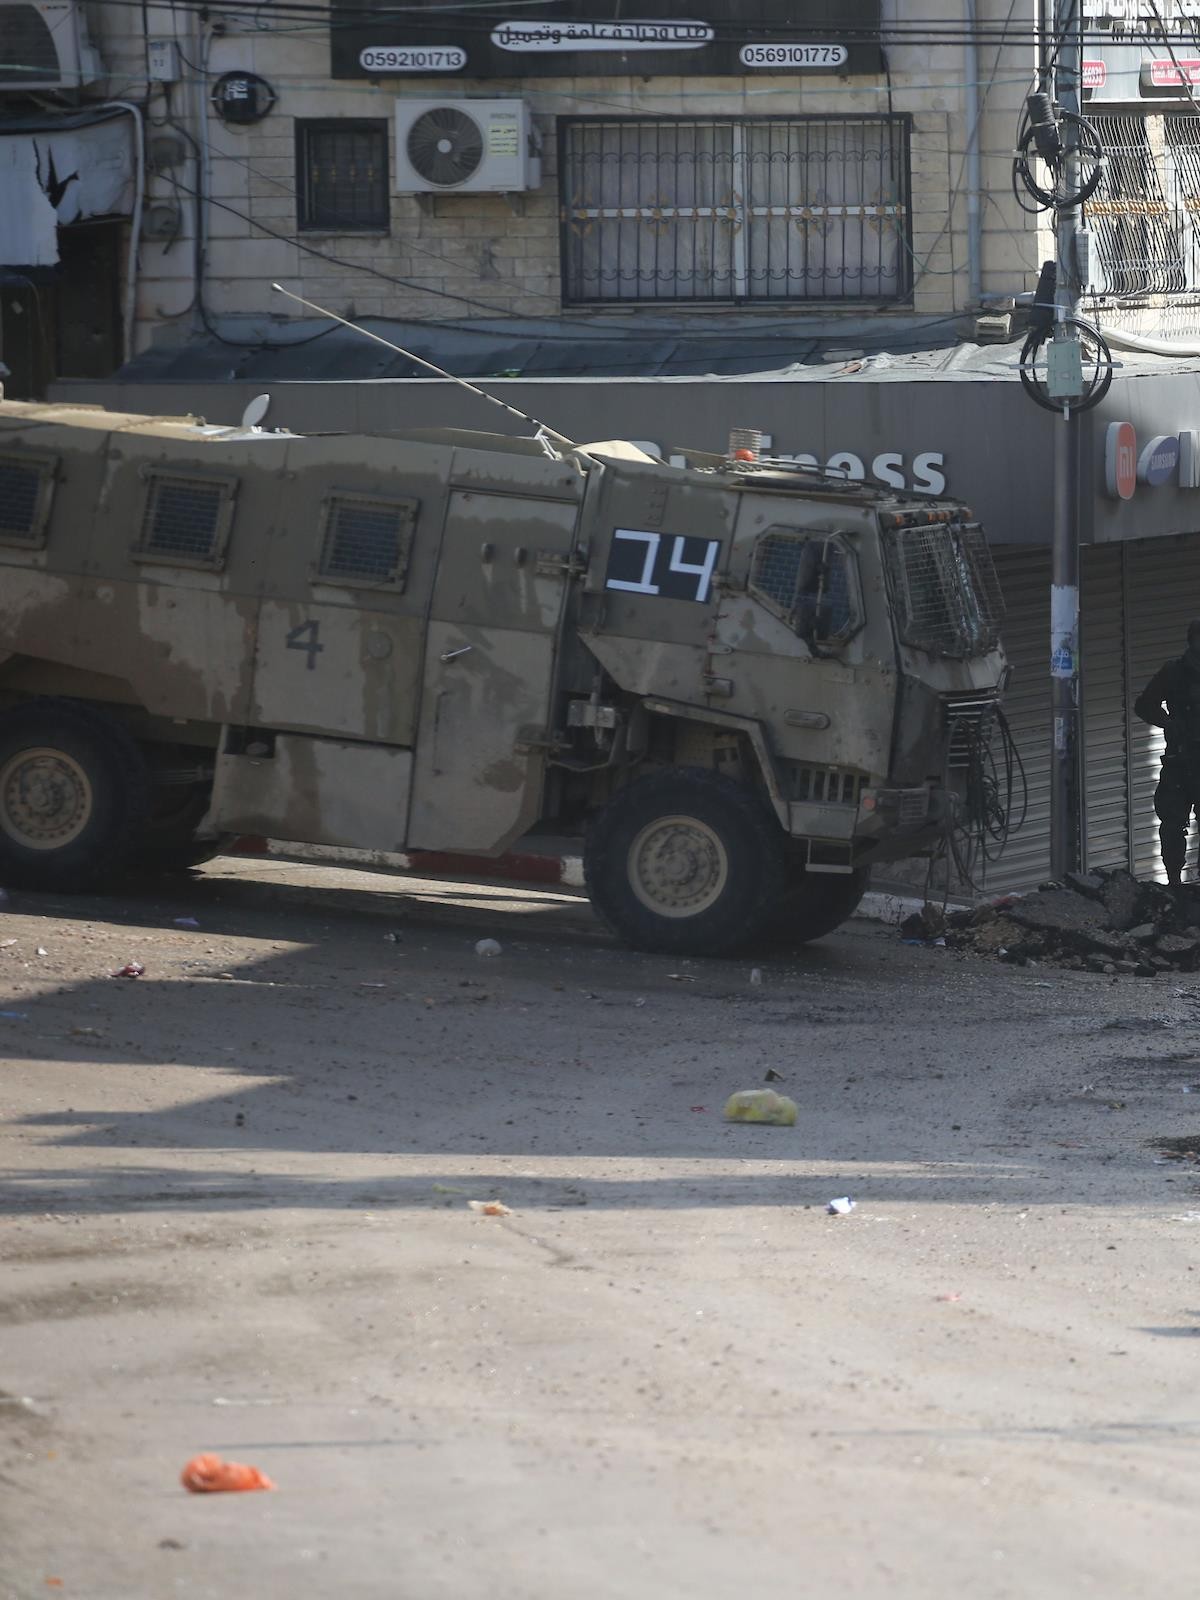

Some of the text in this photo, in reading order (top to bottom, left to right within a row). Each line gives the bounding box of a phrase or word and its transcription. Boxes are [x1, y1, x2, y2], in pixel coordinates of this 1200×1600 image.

[364, 52, 461, 67] 0592101713
[744, 48, 841, 64] 0569101775
[286, 620, 324, 670] 4
